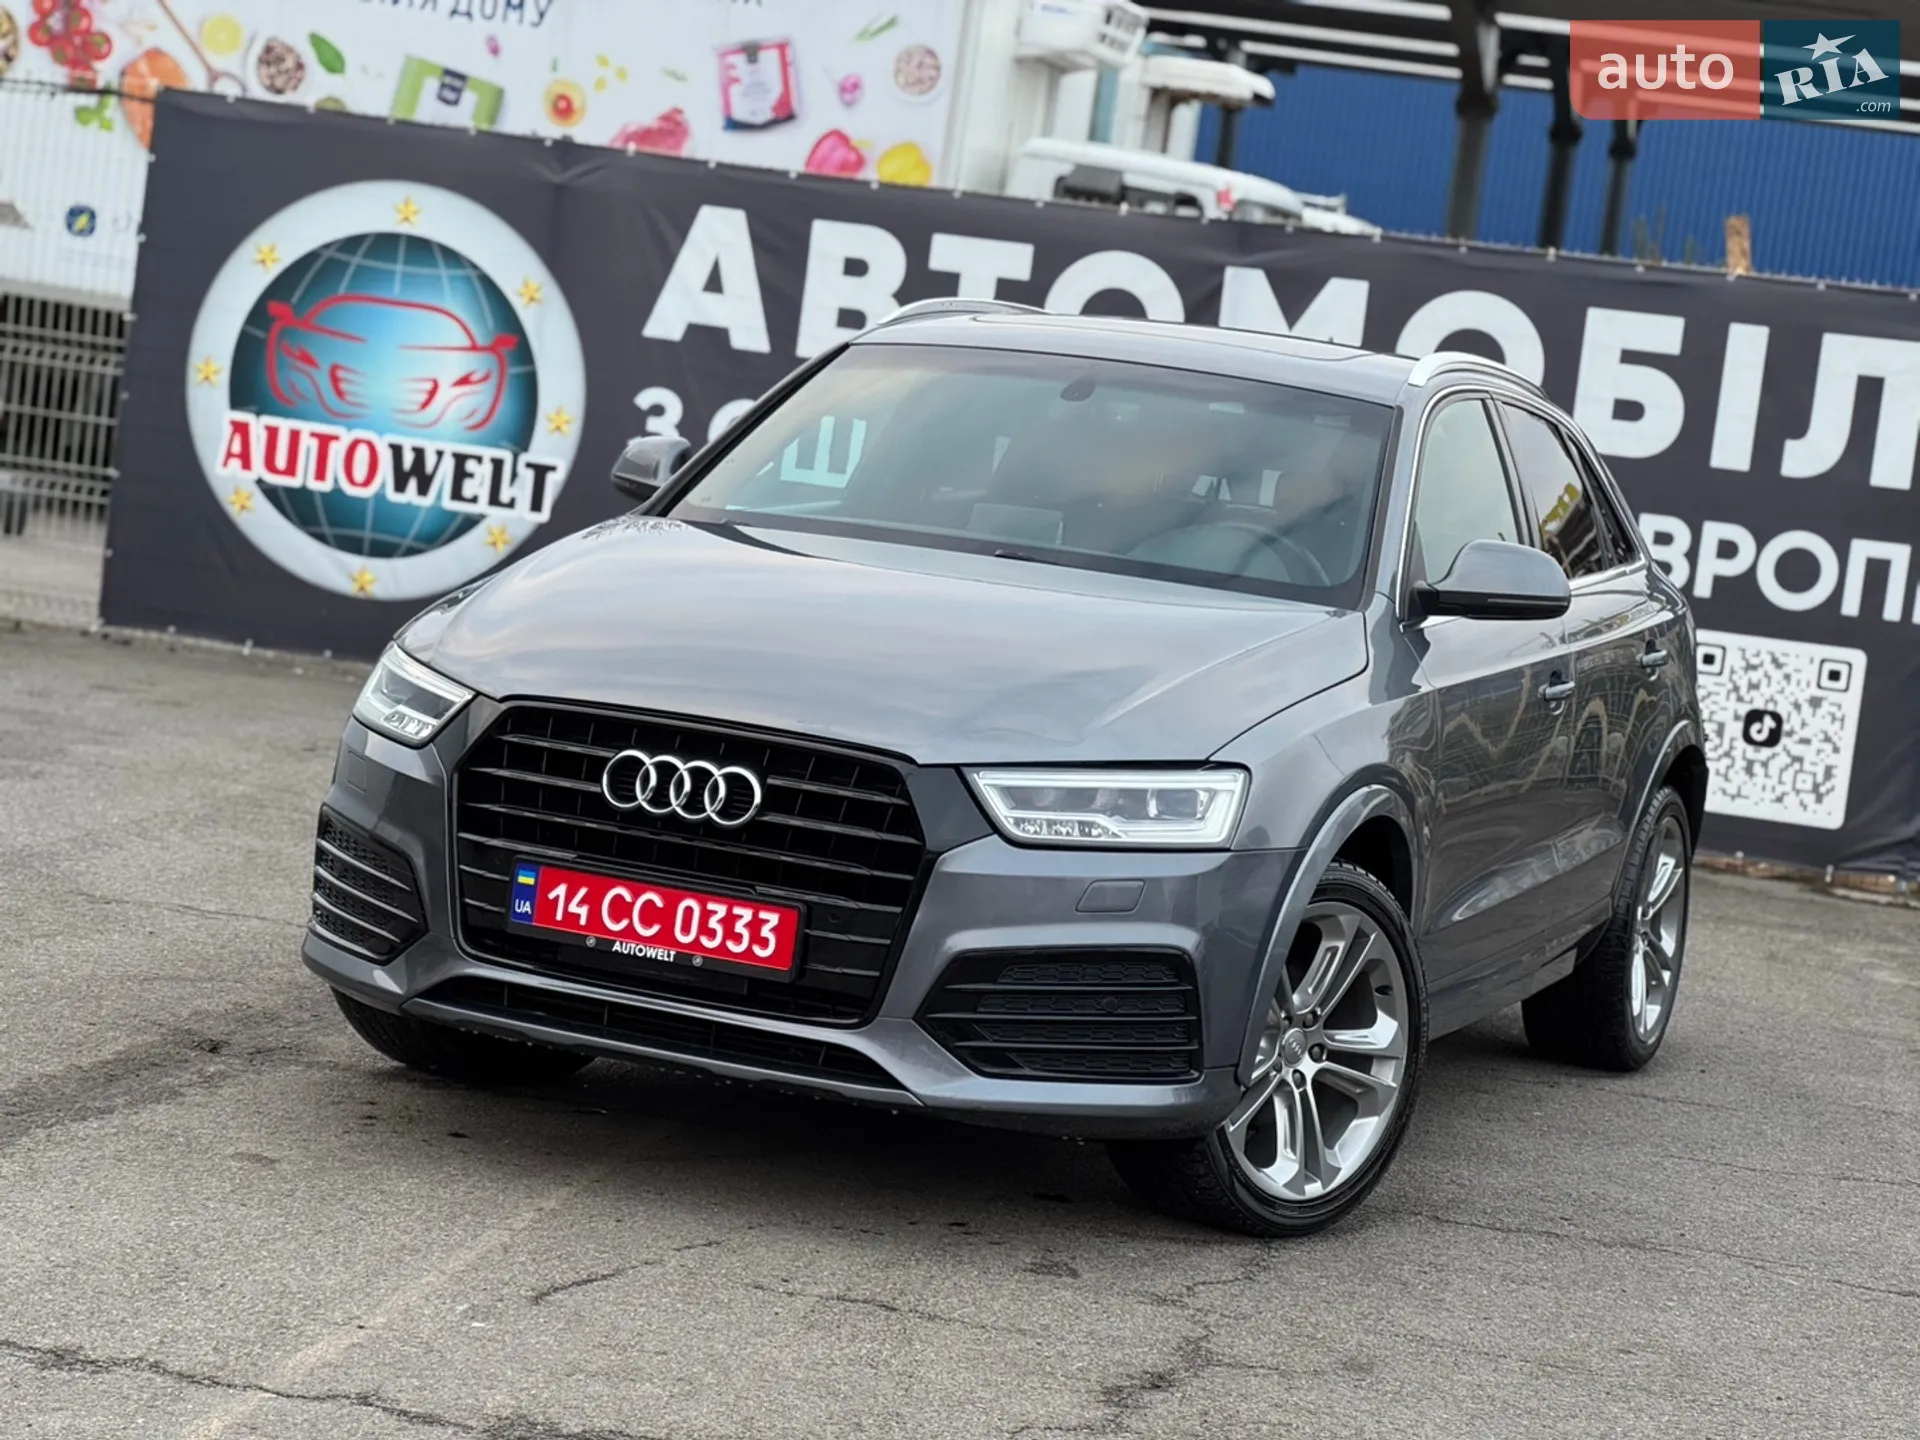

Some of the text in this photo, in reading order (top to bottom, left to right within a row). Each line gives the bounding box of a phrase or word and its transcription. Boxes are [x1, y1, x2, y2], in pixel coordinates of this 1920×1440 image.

[222, 419, 557, 514] AUTOWELT
[1638, 512, 1920, 625] ВРОП
[514, 898, 532, 915] UA
[547, 883, 780, 958] 14 CC 0333
[612, 940, 677, 963] AUTOWELT
